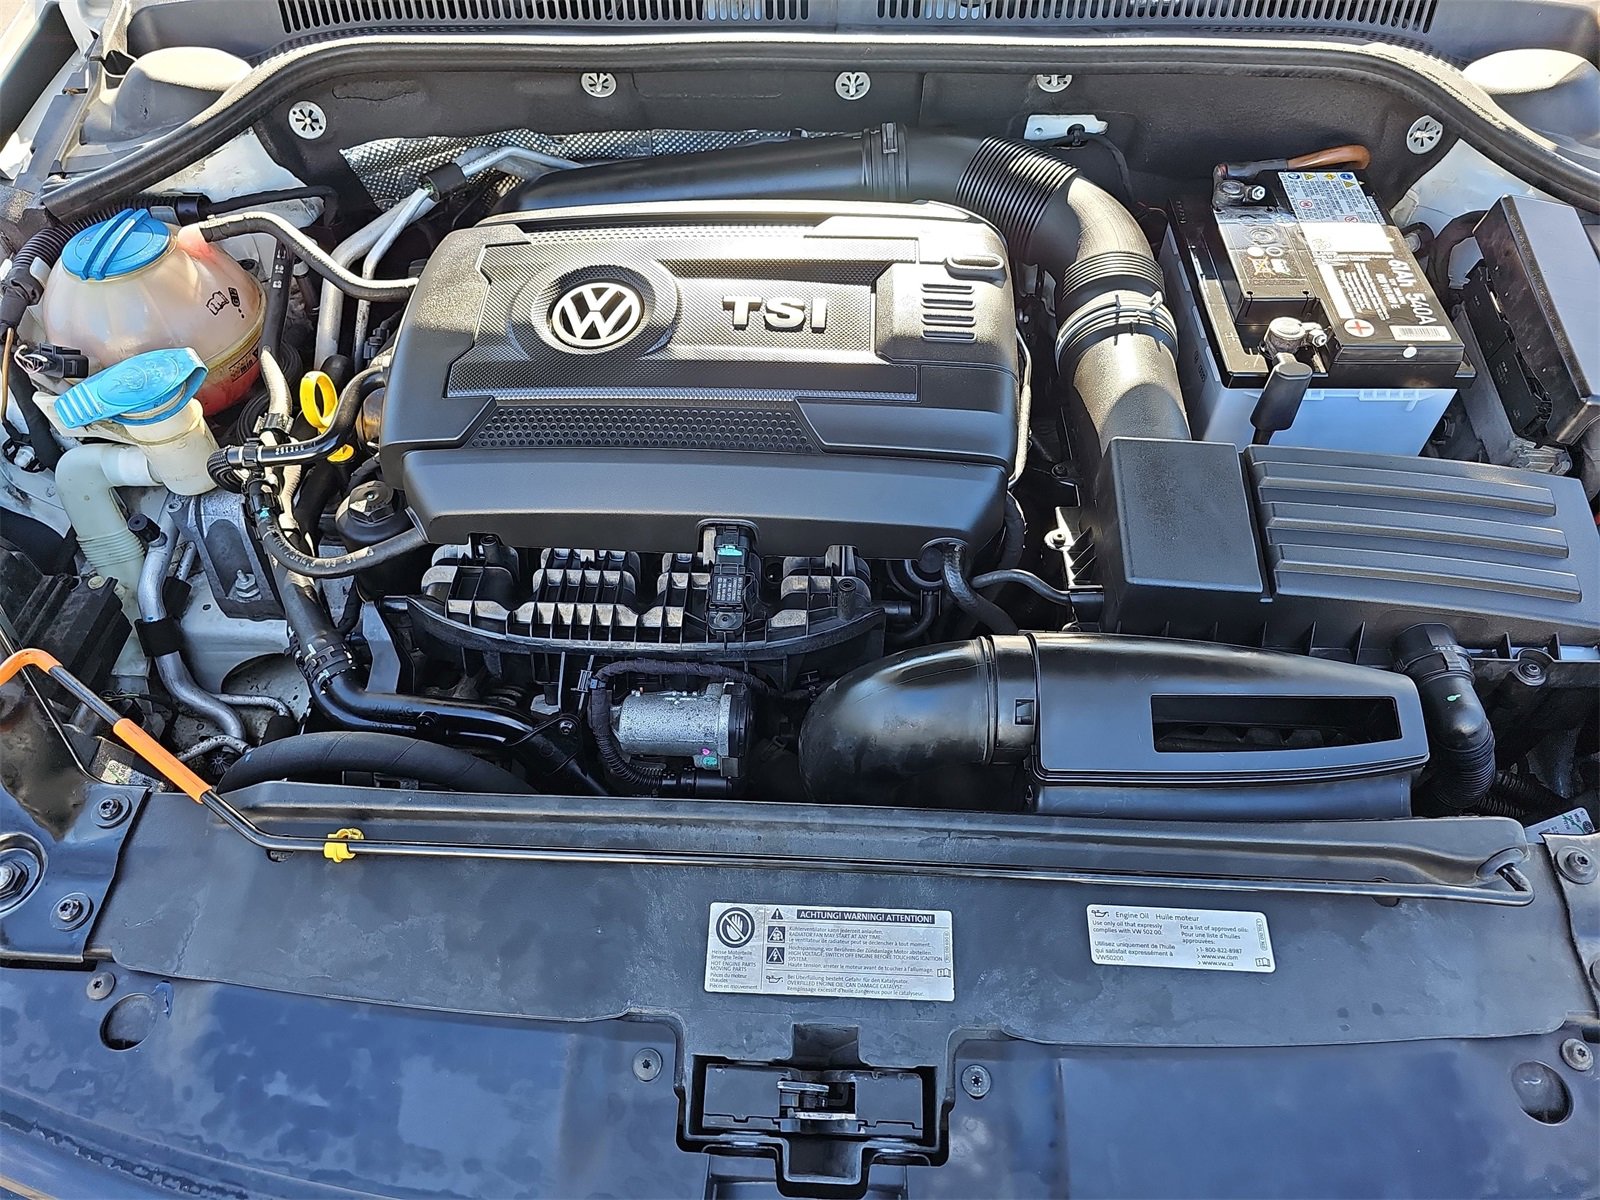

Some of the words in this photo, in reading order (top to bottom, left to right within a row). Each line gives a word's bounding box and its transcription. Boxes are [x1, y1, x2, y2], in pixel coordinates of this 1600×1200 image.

[1388, 259, 1417, 287] 61Ah
[1405, 293, 1438, 325] 540A
[552, 282, 643, 348] VW
[723, 295, 828, 331] TSI
[800, 911, 842, 919] ACHTUNG!
[843, 912, 885, 921] WARNING!
[886, 914, 932, 923] ATTENTION!
[1116, 911, 1138, 920] Engine
[1155, 913, 1174, 921] Huile
[1175, 914, 1200, 922] moteur
[1116, 941, 1150, 949] uniquement
